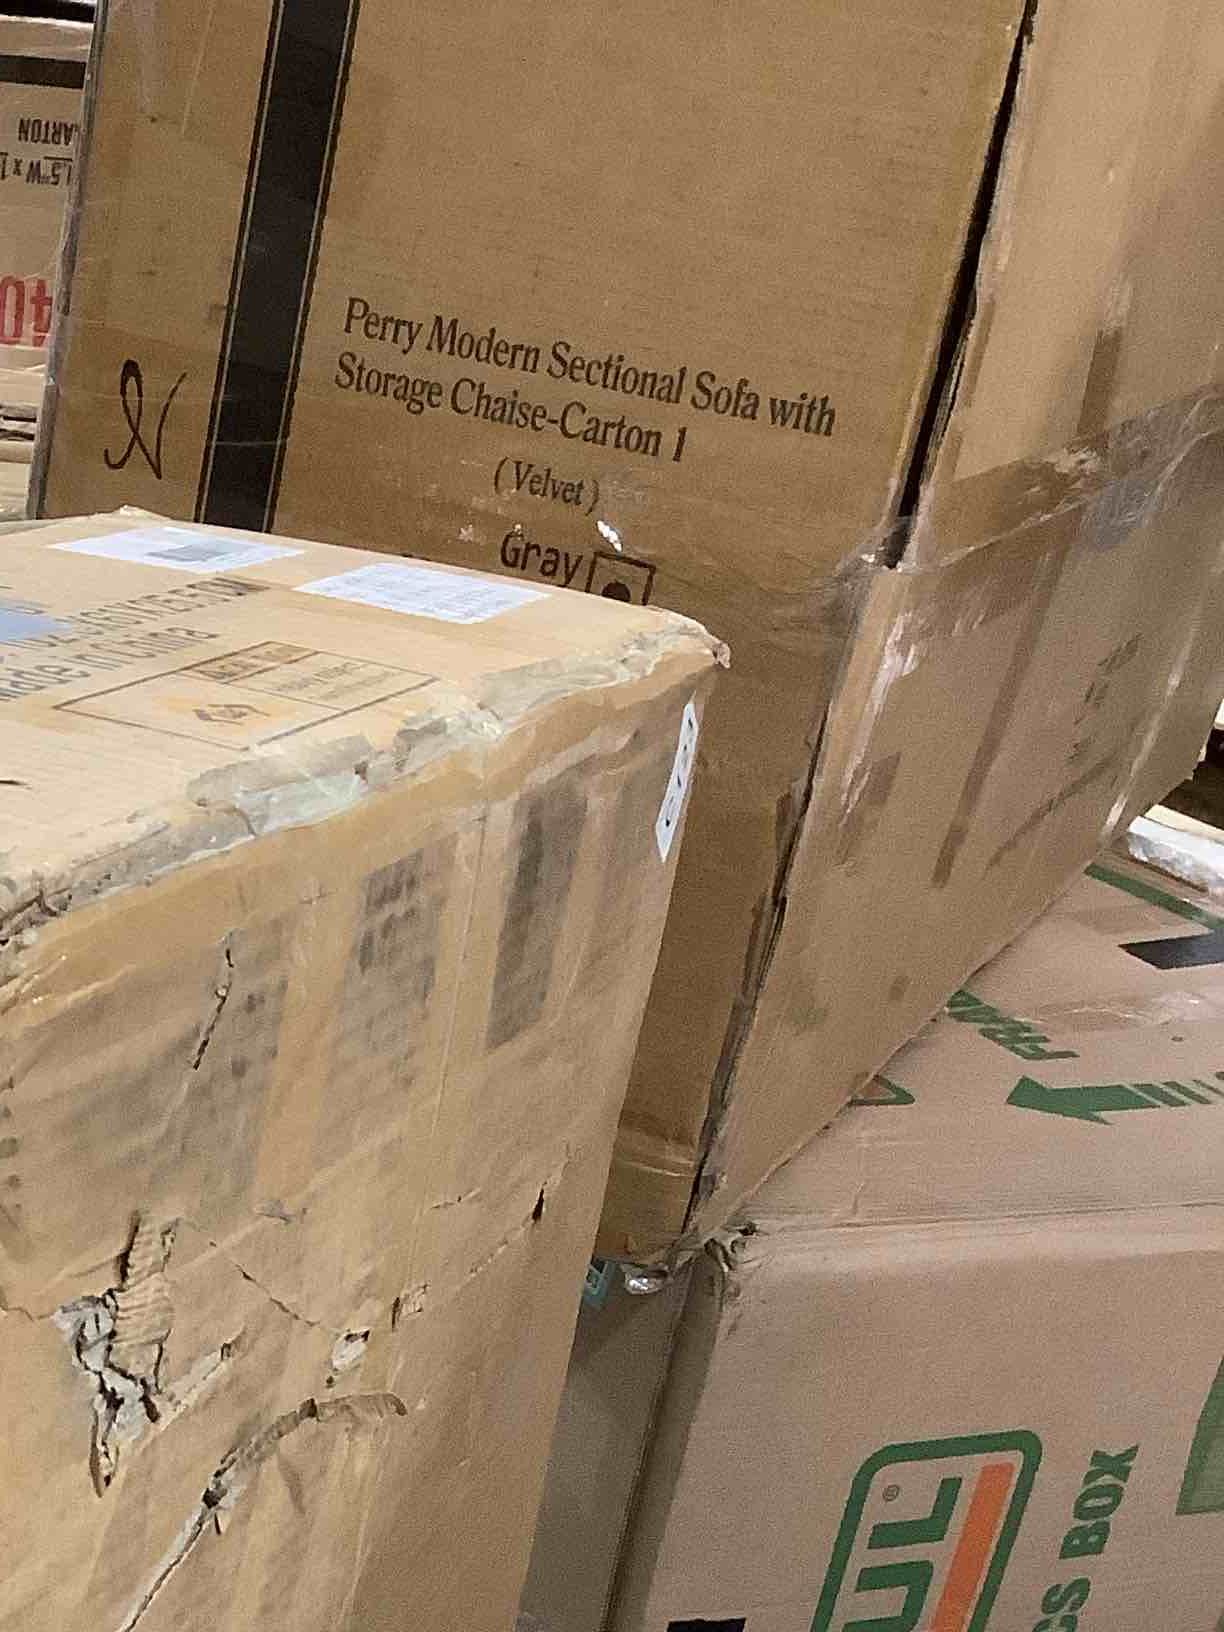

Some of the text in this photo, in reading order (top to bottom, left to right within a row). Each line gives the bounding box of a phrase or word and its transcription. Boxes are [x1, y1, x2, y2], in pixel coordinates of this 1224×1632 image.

[18, 117, 79, 147] ARTON
[334, 351, 688, 462] Storage Chaise-Carton 1
[343, 296, 837, 437] Perry Modern Sectional Sofa with
[500, 529, 583, 588] Gray
[1058, 1443, 1139, 1560] BOX
